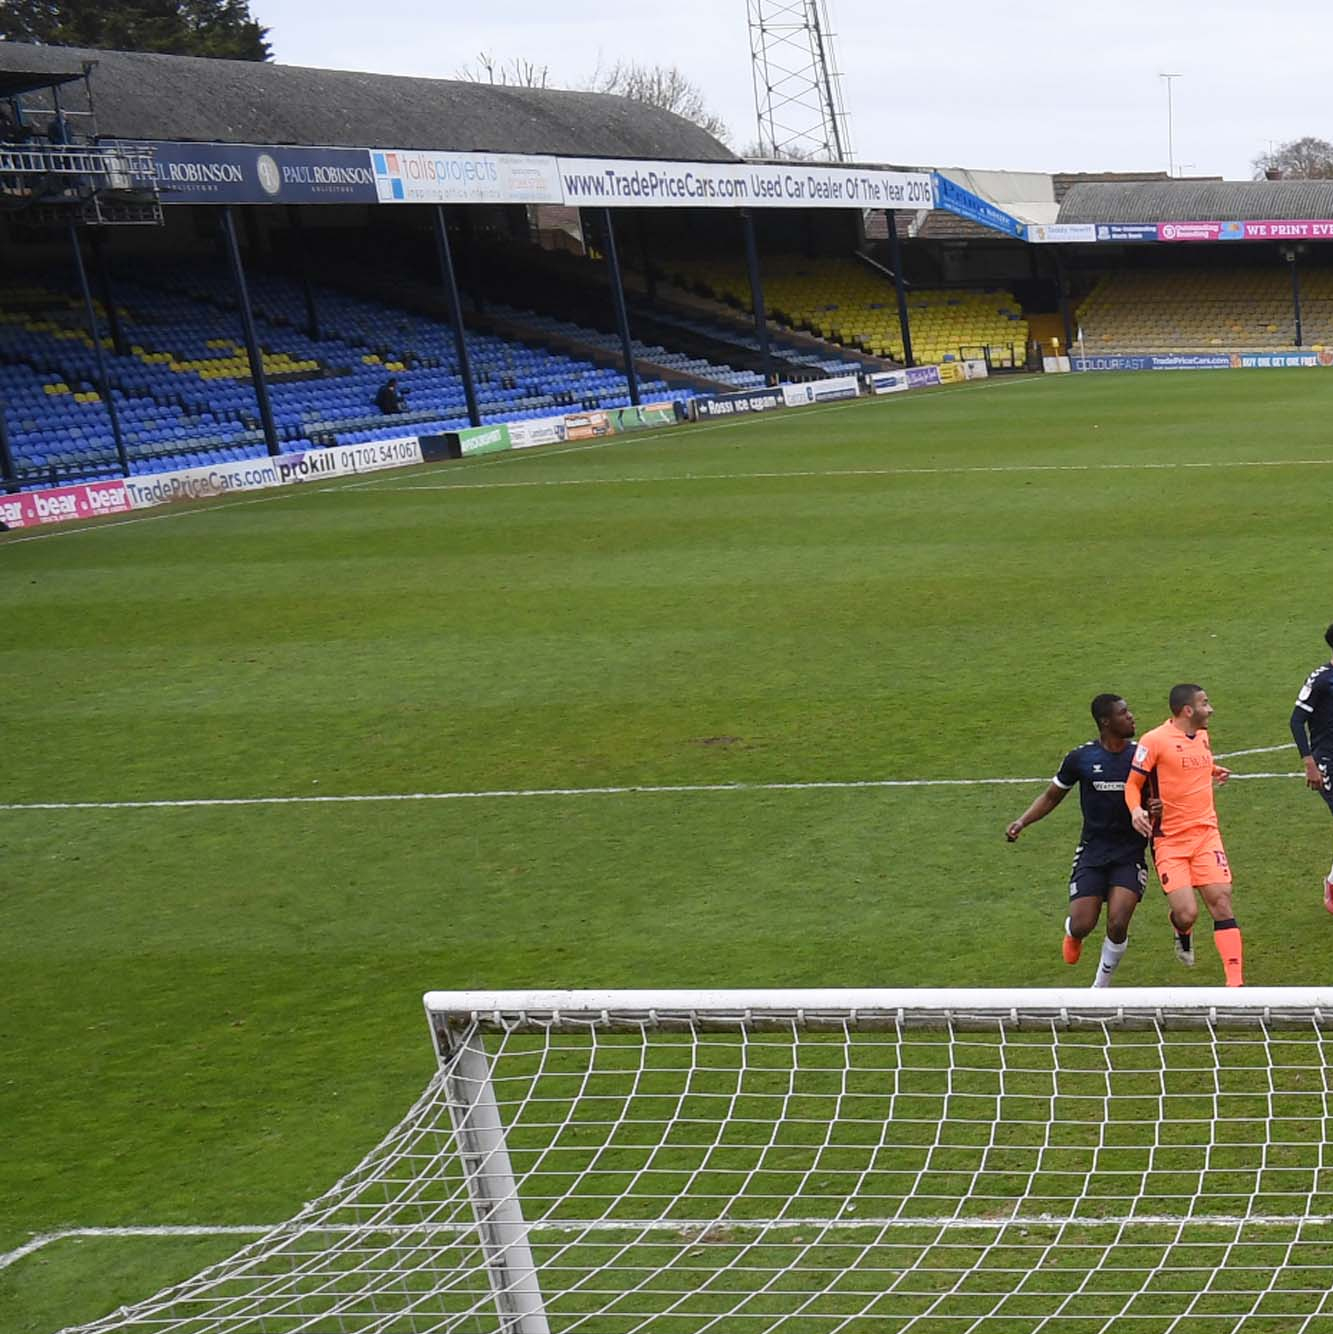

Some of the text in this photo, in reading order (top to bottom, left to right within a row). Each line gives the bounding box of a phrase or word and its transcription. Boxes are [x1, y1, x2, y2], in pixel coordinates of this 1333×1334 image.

[170, 163, 243, 182] ROBINSON
[283, 166, 373, 185] PAUL ROBINSON
[564, 170, 749, 198] www.TradePriceCars.com
[751, 174, 782, 198] Used
[785, 175, 805, 199] Car
[808, 177, 843, 200] Dealer
[846, 178, 859, 199] Of
[861, 179, 880, 200] The
[883, 180, 905, 201] Year
[907, 182, 931, 202] 2016
[1246, 225, 1267, 235] WE
[1271, 225, 1308, 235] PRINT
[1076, 358, 1145, 370] COLOURFAST
[1152, 357, 1229, 365] TradePriceCars.com
[708, 400, 734, 415] Rossi
[280, 441, 418, 483] prokill 01702 541067
[128, 465, 276, 504] TradePriceCars.com
[33, 494, 77, 517] bear
[86, 487, 125, 509] bear
